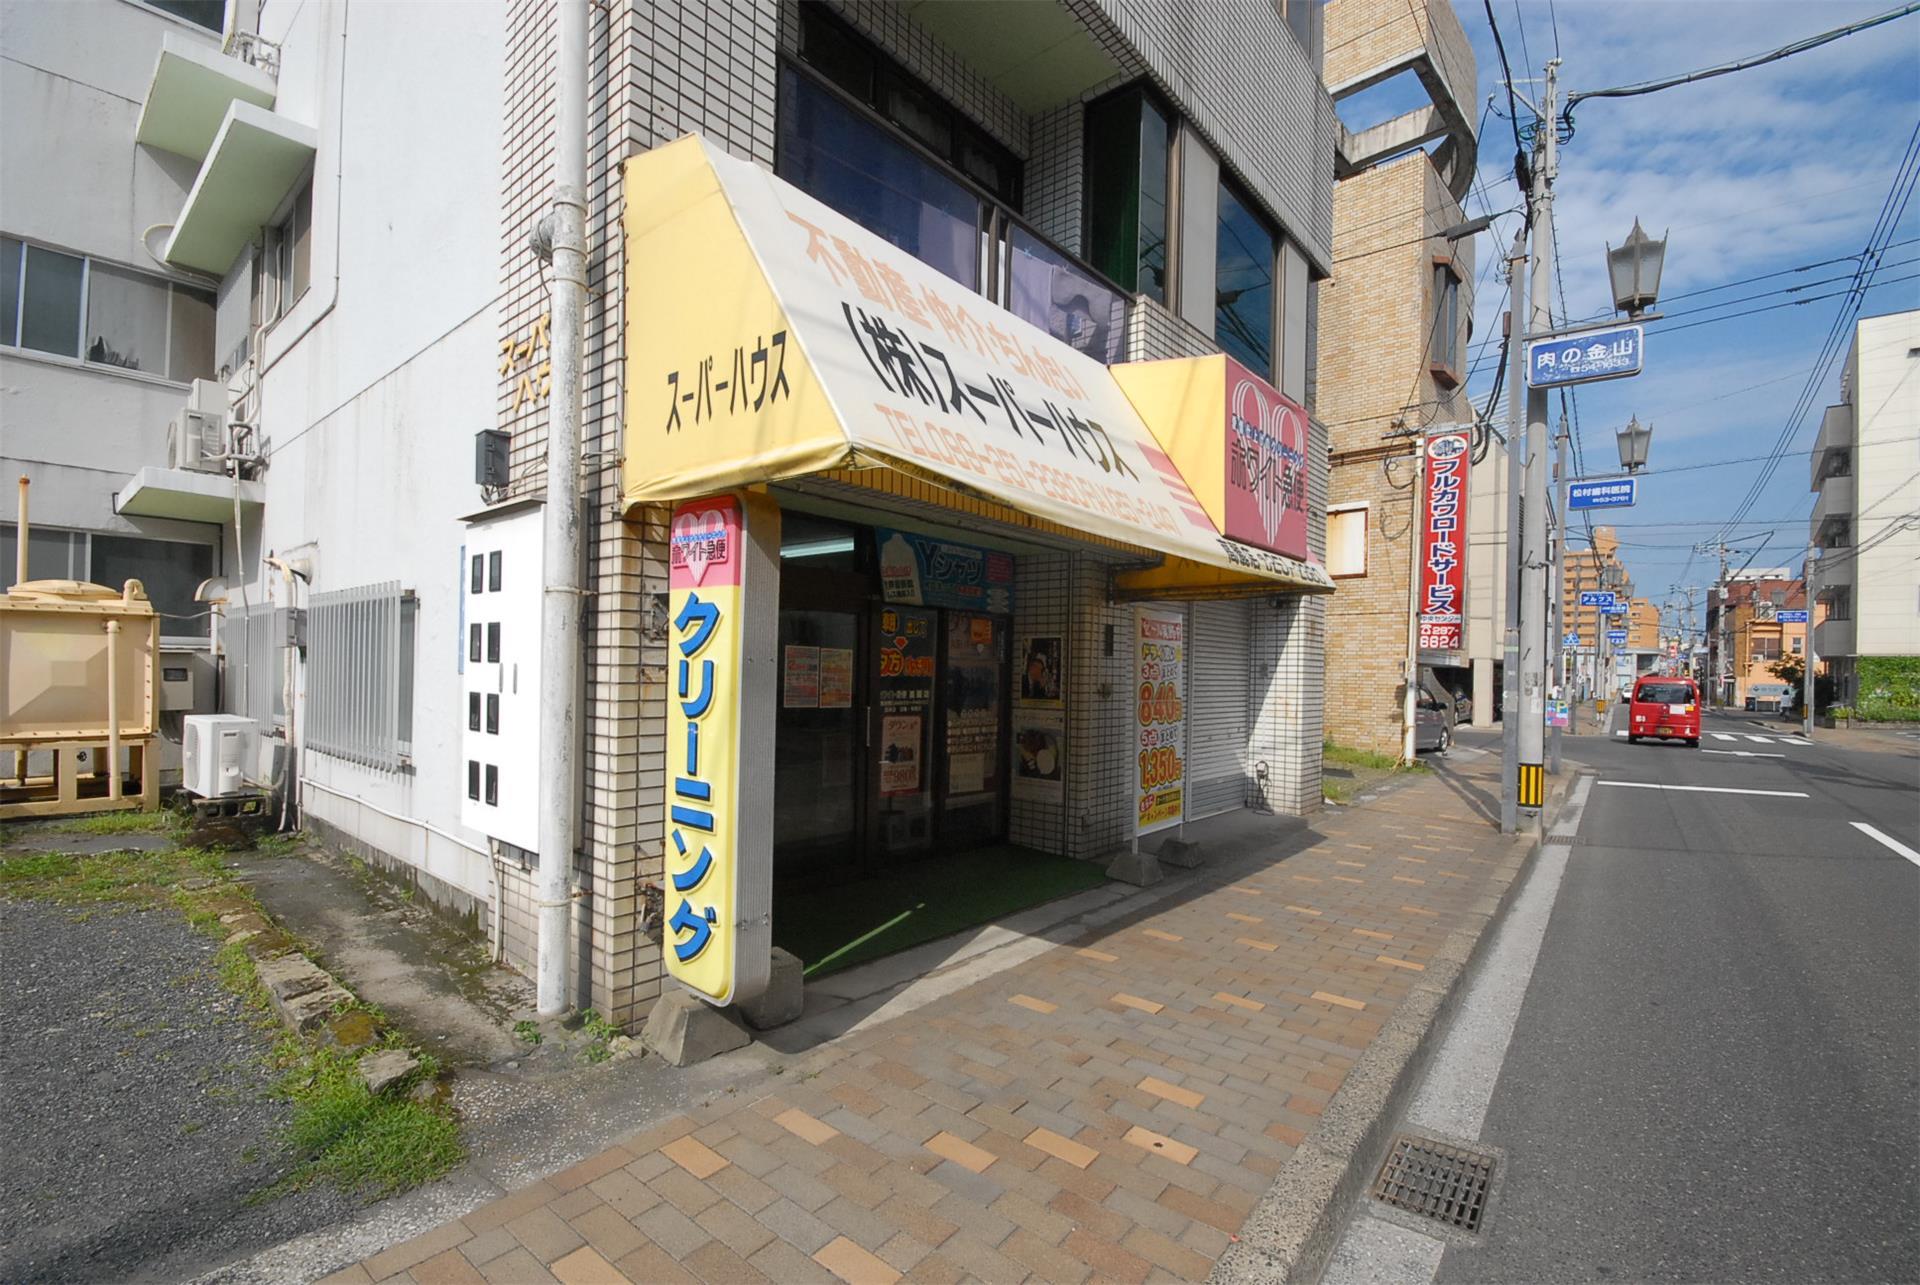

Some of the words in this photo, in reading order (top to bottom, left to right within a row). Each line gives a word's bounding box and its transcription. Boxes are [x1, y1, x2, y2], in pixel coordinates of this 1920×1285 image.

[666, 331, 790, 434] スーパーハウス
[1537, 338, 1634, 370] 肉の金山
[671, 539, 727, 565] ホワイト急便
[1427, 458, 1460, 614] フルカワロードサービス
[669, 592, 721, 964] クリーニング
